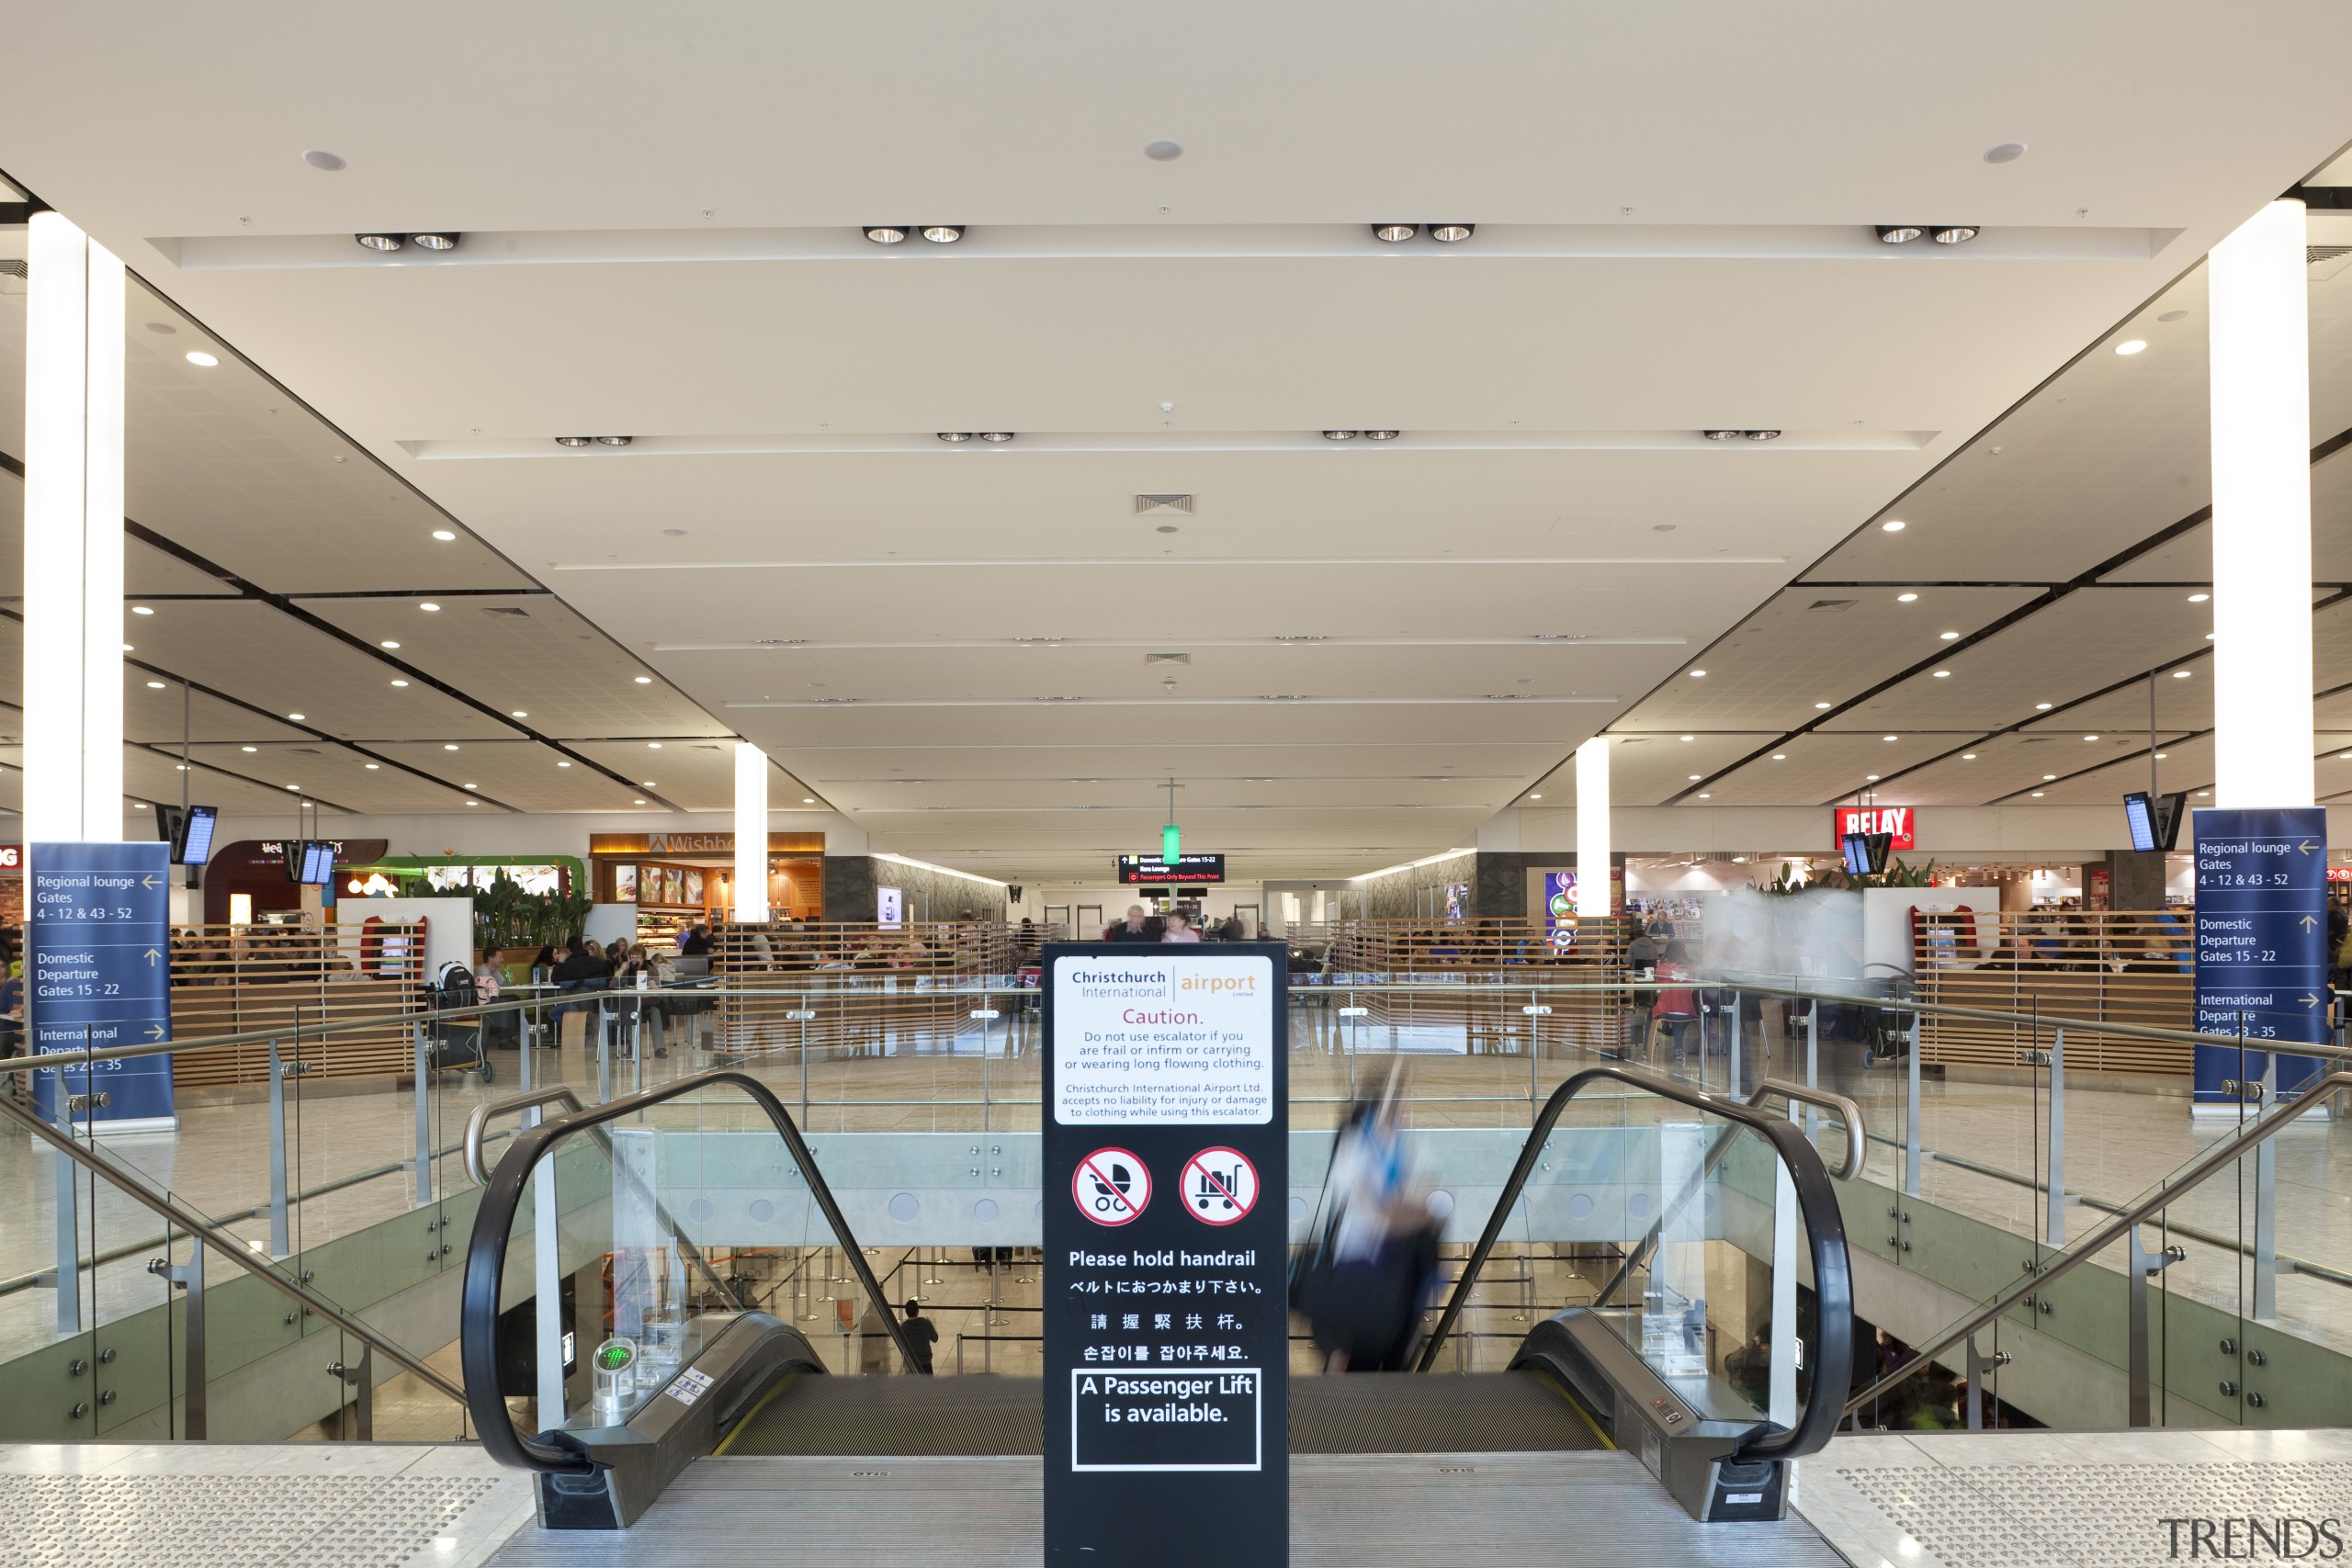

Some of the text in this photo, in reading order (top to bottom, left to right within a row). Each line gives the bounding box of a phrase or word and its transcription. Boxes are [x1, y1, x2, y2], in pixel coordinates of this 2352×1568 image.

[1847, 808, 1906, 837] RELAY
[2199, 841, 2291, 857] Regional lounge
[0, 849, 17, 865] G
[1152, 865, 1170, 874] Lounge
[2199, 859, 2232, 870] Gates
[37, 874, 135, 890] Regional lounge
[2199, 874, 2207, 886] 4
[2218, 874, 2232, 886] 12
[2235, 874, 2245, 886] &
[2247, 874, 2263, 886] 43
[2274, 874, 2289, 886] 52
[37, 892, 73, 904] Gates
[37, 908, 46, 919] 4
[58, 908, 74, 919] 12
[76, 908, 87, 919] &
[89, 908, 106, 919] 43
[118, 908, 132, 919] 52
[2200, 918, 2253, 930] Domestic
[2200, 934, 2256, 949] Departure
[38, 952, 95, 964] Domestic
[2200, 950, 2233, 962] Gates
[2235, 950, 2250, 962] 15
[2261, 950, 2276, 962] 22
[38, 969, 99, 983] Departure
[1072, 970, 1166, 984] Christchurch
[38, 985, 74, 997] Gates
[77, 984, 93, 996] 15
[104, 983, 119, 995] 22
[1181, 974, 1255, 994] airport
[1082, 985, 1166, 998] International
[2200, 993, 2273, 1006] International
[1123, 1008, 1204, 1025] Caution.
[2199, 1010, 2256, 1024] Departre
[40, 1026, 118, 1042] Internatonal
[1084, 1031, 1243, 1043] Do not use escalator if you
[2261, 1026, 2276, 1037] 35
[1080, 1044, 1250, 1057] are frail or infirm or carrying
[106, 1058, 122, 1071] 35
[1065, 1057, 1264, 1072] or wearing long flowing clothing.
[1066, 1083, 1263, 1094] Christchurch International Airport Ltd.
[1062, 1097, 1101, 1107] accepts
[1120, 1095, 1158, 1107] liability
[1160, 1095, 1176, 1104] for
[1179, 1095, 1208, 1107] injury
[1226, 1095, 1268, 1106] damage
[1070, 1107, 1262, 1119] to clothing while using this escalator.
[1069, 1249, 1256, 1267] Please hold handrail
[1069, 1280, 1261, 1294] ベルトにおつかまり下さい。
[1083, 1345, 1249, 1361] 손잡이를 잡아주세요.
[1080, 1374, 1253, 1400] A Passenger Lift
[1104, 1402, 1228, 1423] is available.
